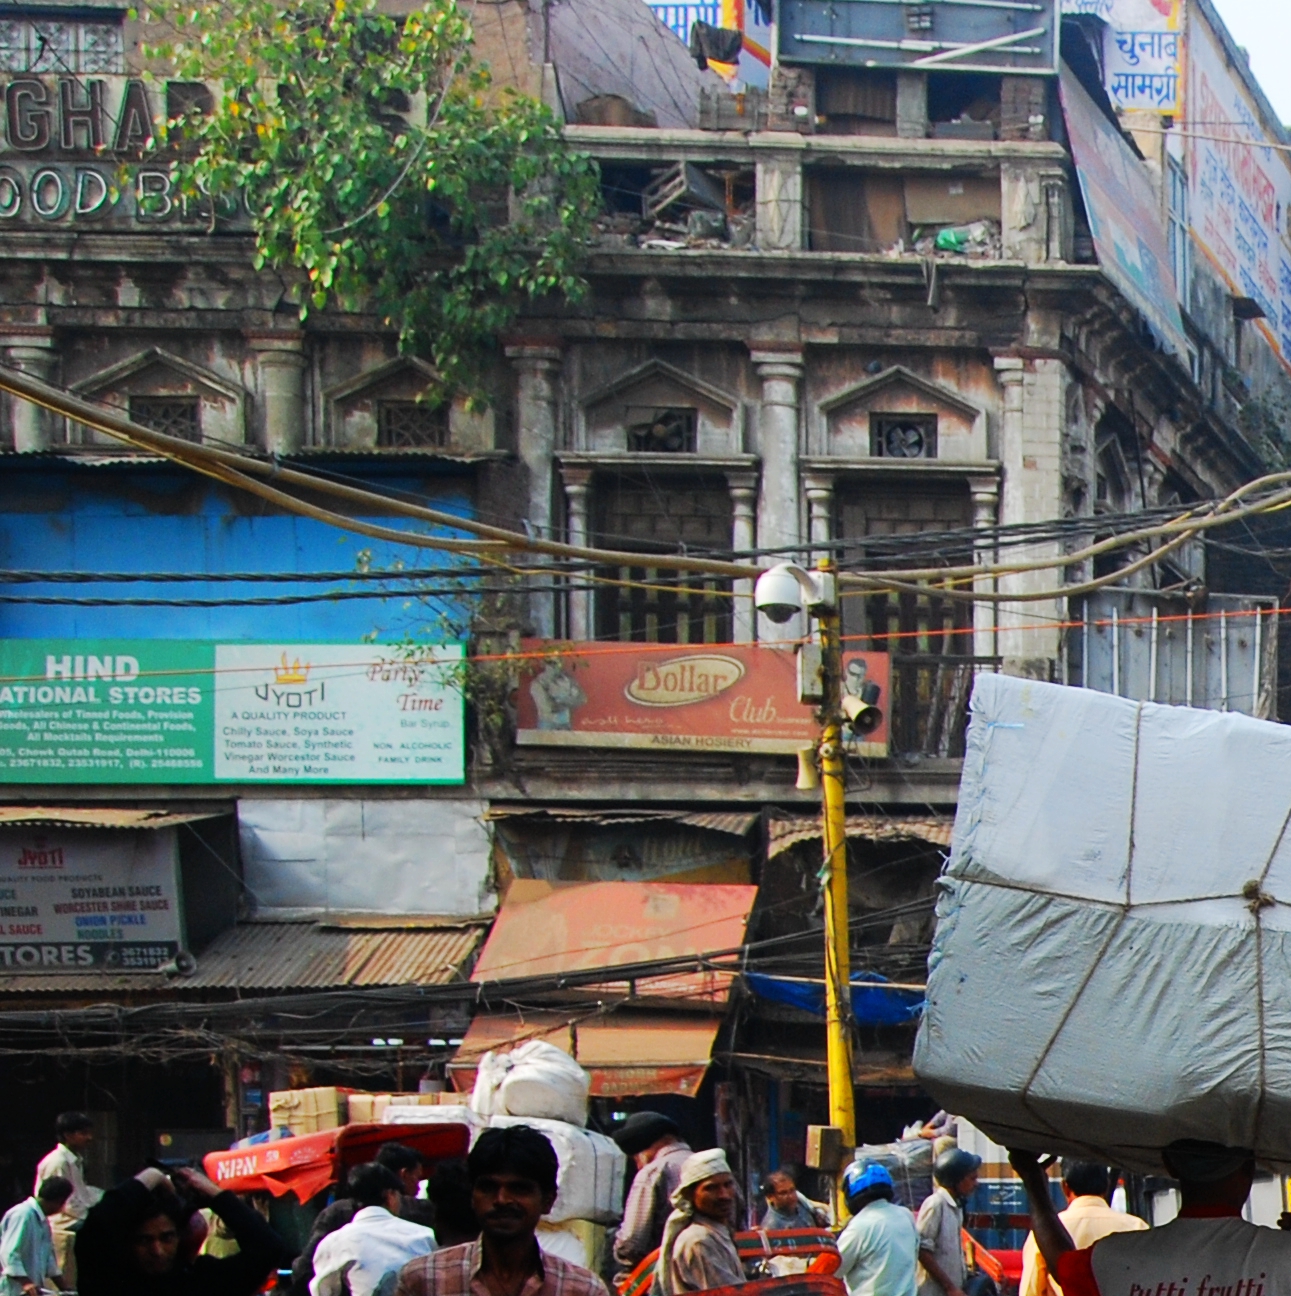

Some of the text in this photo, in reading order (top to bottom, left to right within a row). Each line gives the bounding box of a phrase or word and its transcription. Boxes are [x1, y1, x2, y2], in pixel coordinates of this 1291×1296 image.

[1111, 66, 1179, 107] सामग्री
[46, 655, 140, 682] HIND
[636, 661, 728, 693] Dollar
[109, 687, 202, 704] STORES
[396, 693, 444, 712] Time
[729, 695, 777, 724] Club
[231, 711, 347, 721] A QUALITY PRODUCT
[223, 727, 252, 738] Chilly
[294, 727, 319, 738] Soya
[323, 727, 354, 736] Sauce
[225, 740, 263, 750] Tomato
[304, 740, 352, 751] Synthetic
[400, 742, 452, 750] ALCOHOLIC
[651, 735, 752, 749] ASIAN HOSIERY
[224, 752, 264, 763] Vinegar
[324, 753, 355, 762] Sauce
[378, 755, 442, 763] FAMILY DRINK
[249, 765, 329, 777] And Many More
[71, 885, 162, 899] SOYABEAN SAUCE
[140, 900, 169, 911] SAUCE
[9, 924, 43, 935] SAUCE
